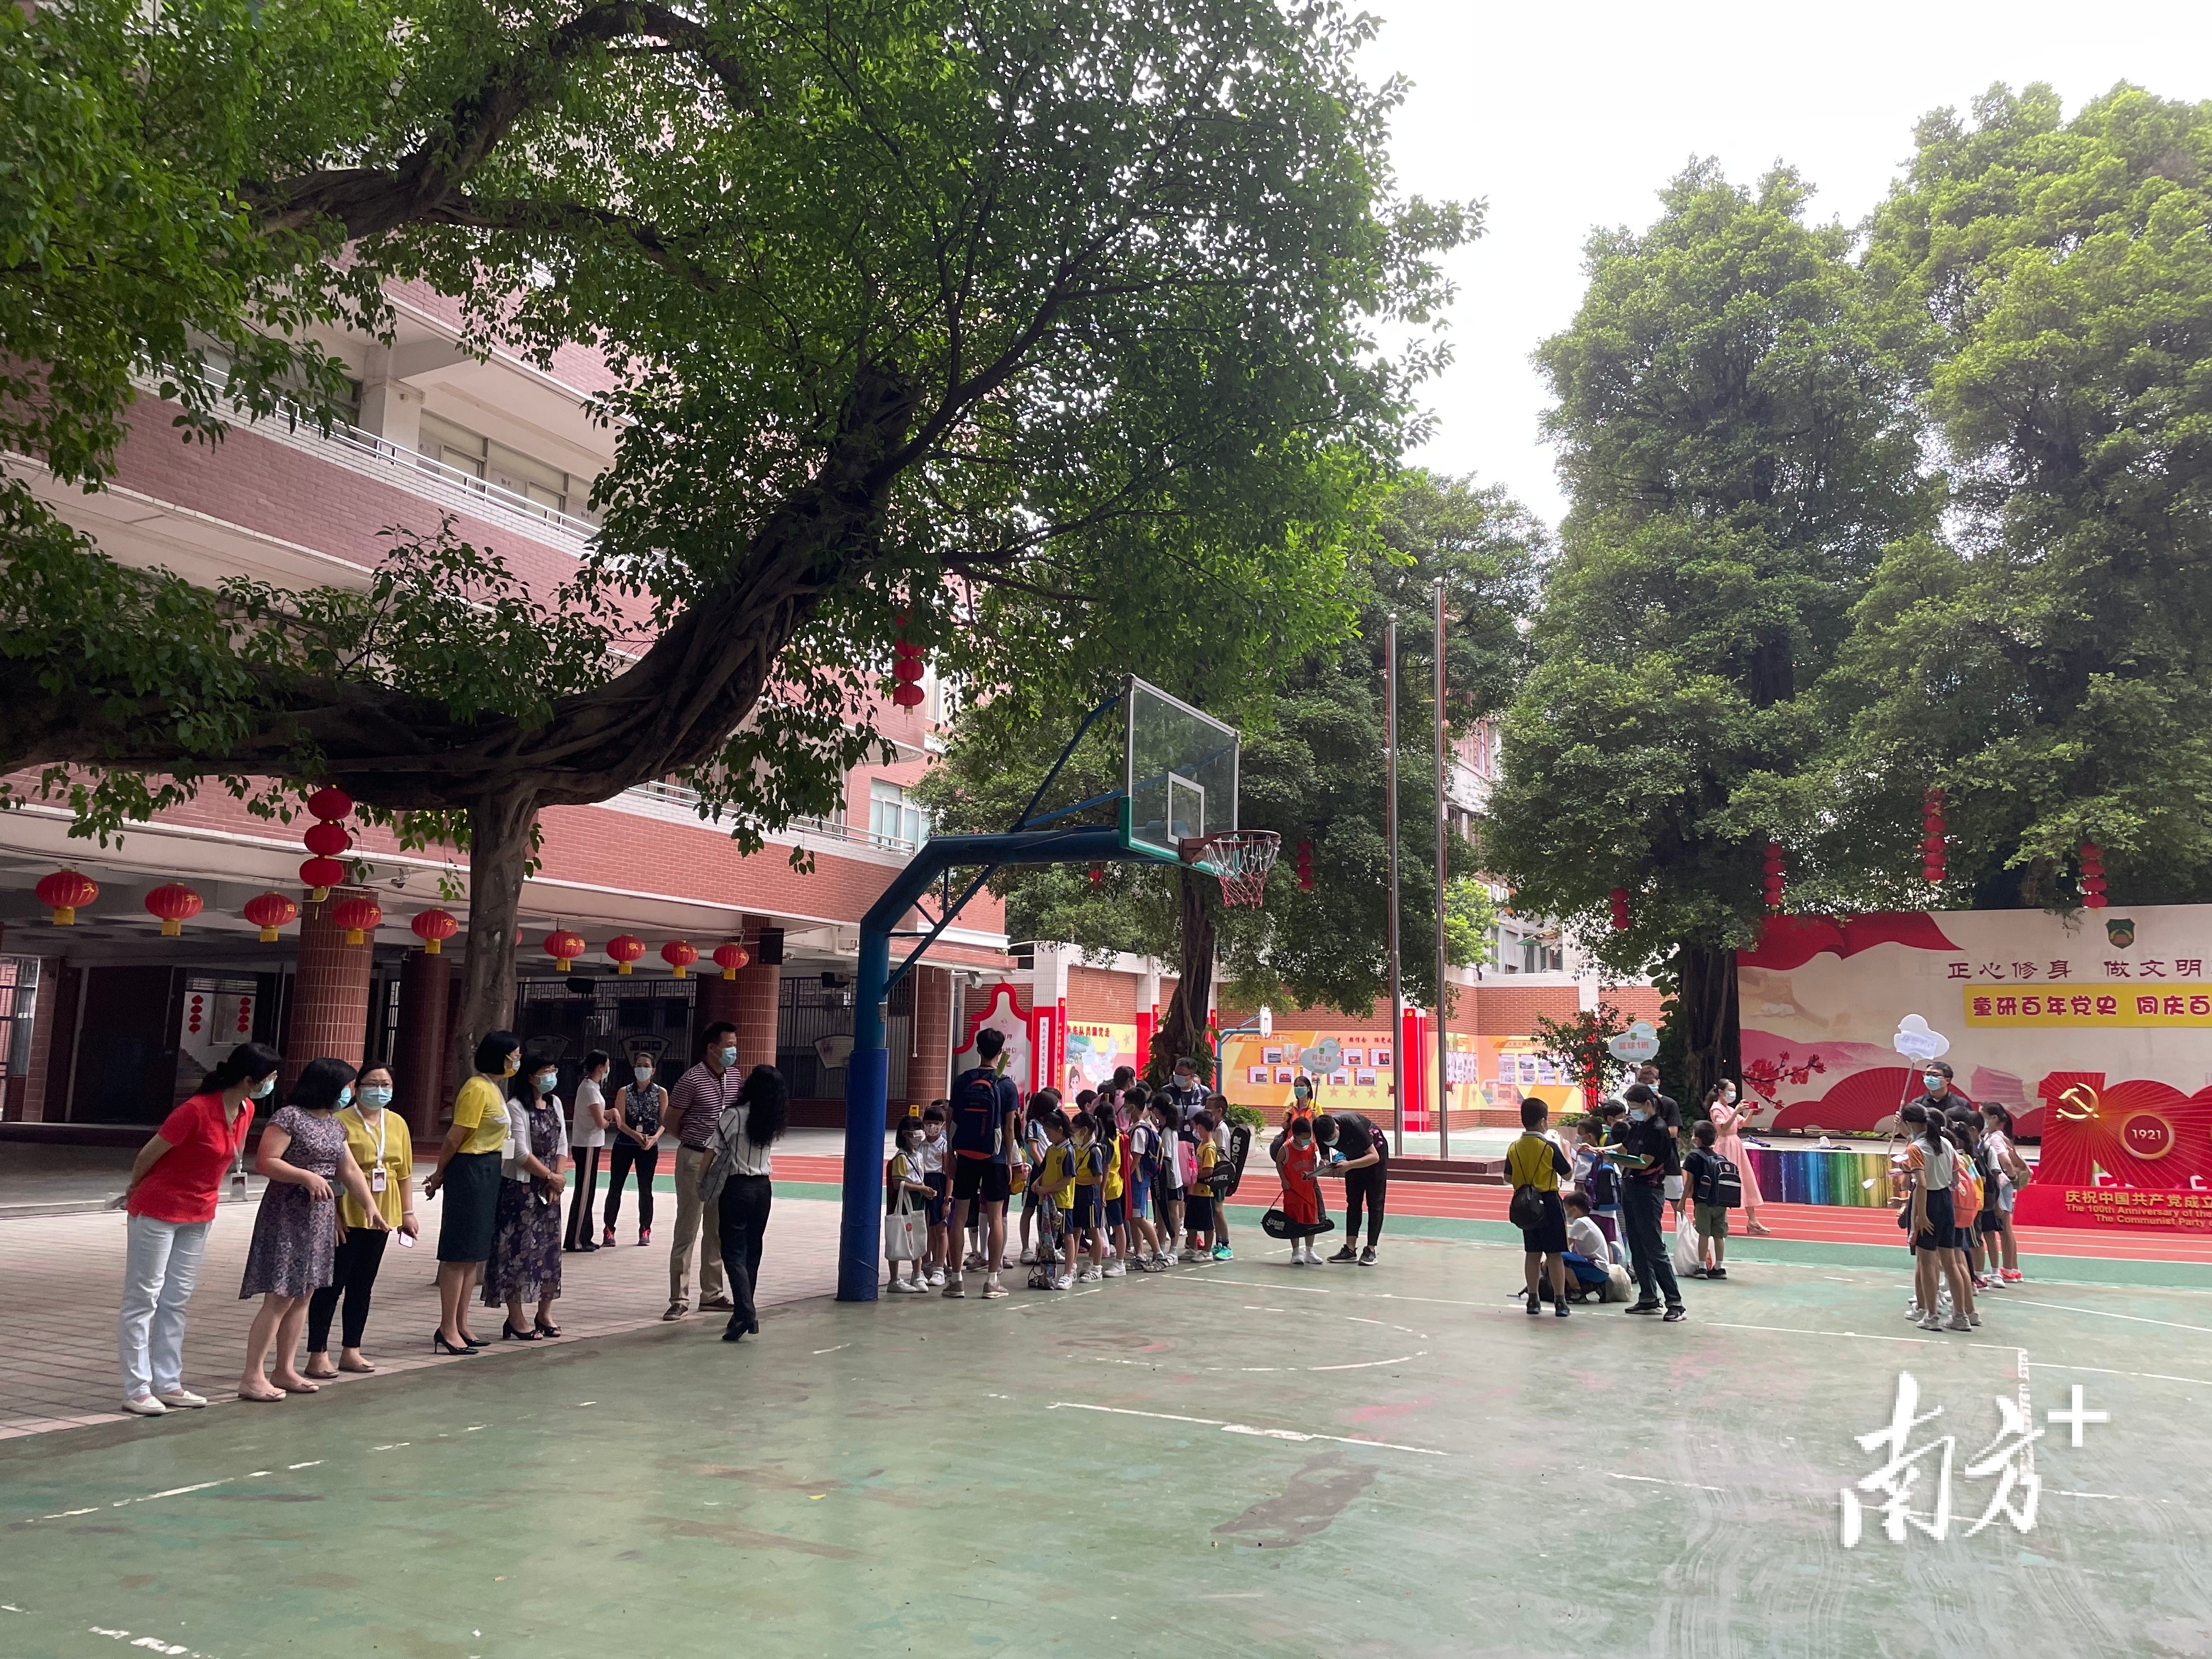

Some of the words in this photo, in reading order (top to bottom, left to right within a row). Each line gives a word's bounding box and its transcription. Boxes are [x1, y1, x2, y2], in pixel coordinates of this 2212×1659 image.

[1948, 960, 2072, 979] 正心修身
[2103, 960, 2212, 978] 做文明
[1973, 995, 2117, 1016] 童研百年党史
[2136, 995, 2210, 1015] 同庆百
[1618, 1041, 1649, 1050] 篮球1班
[2132, 1128, 2161, 1141] 1921
[2066, 1190, 2212, 1209] 庆祝中国共产党成立
[2087, 1205, 2114, 1214] 100th
[2118, 1206, 2179, 1218] Anniversary
[2095, 1214, 2113, 1222] The
[2117, 1215, 2175, 1225] Communist
[2178, 1217, 2205, 1228] Party
